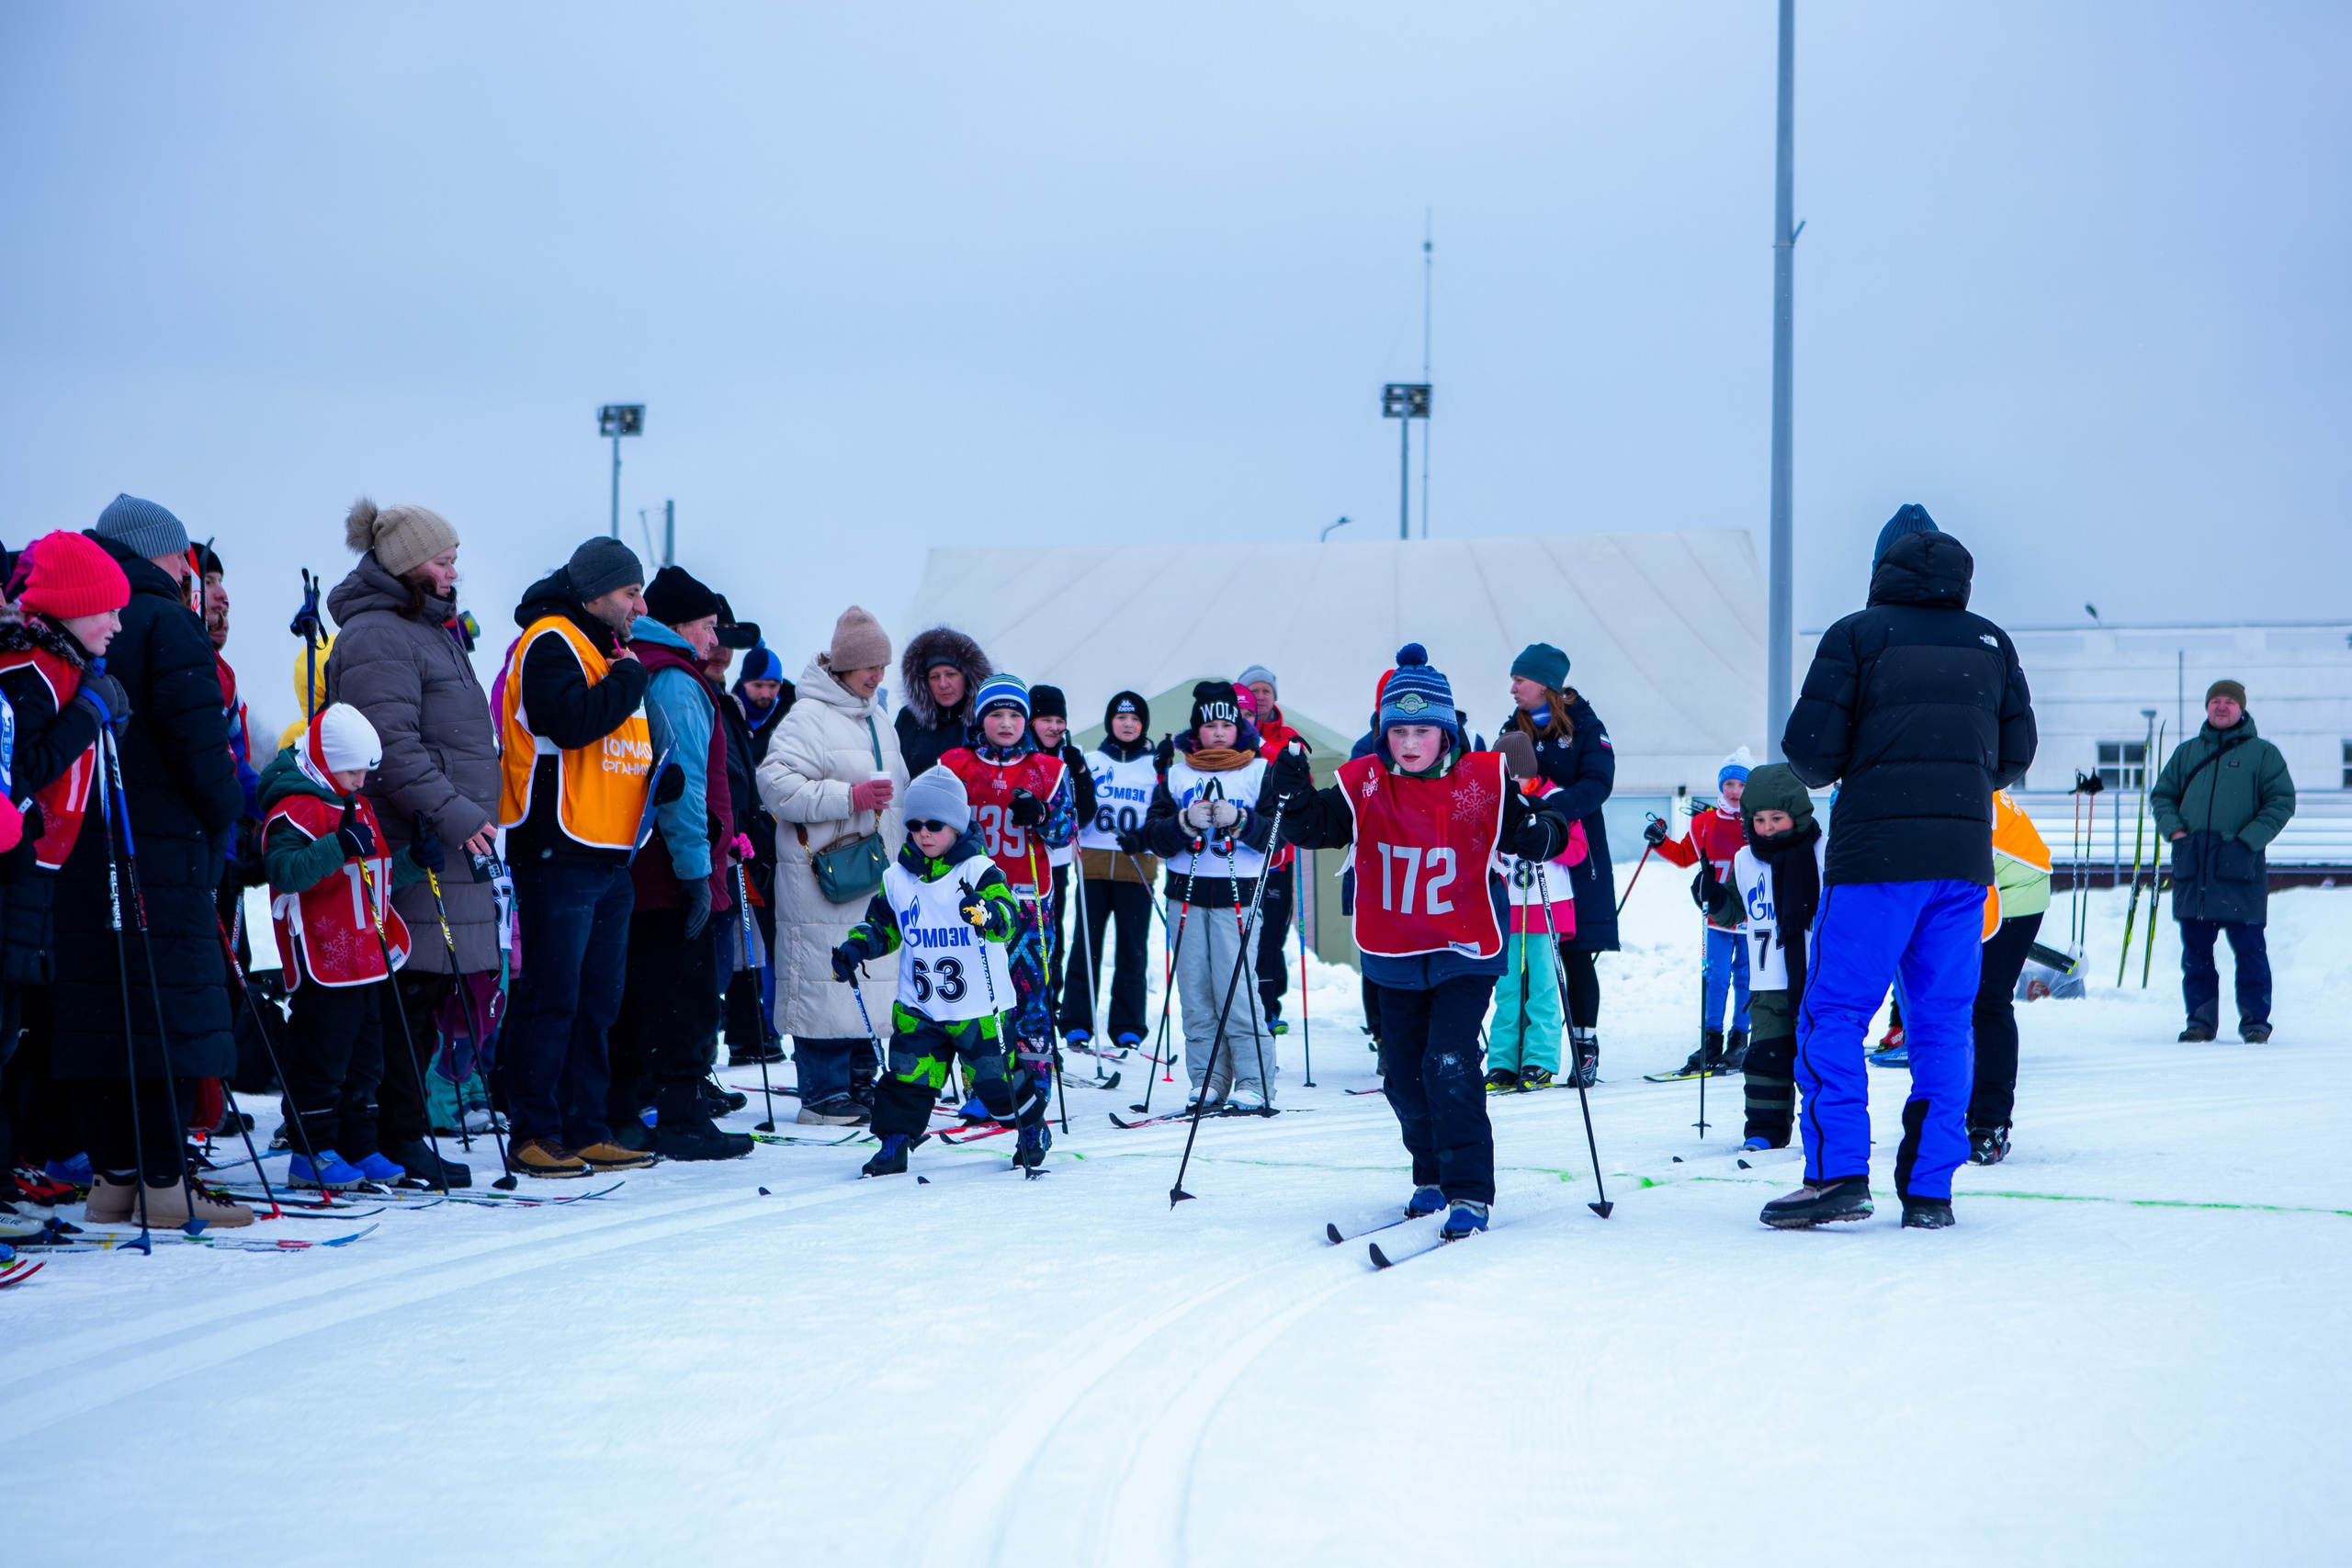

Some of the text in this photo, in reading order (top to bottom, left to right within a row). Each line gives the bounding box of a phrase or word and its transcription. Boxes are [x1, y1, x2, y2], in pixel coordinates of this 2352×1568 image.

[1200, 702, 1238, 723] WOLF
[1094, 804, 1138, 834] 60
[1268, 809, 1283, 851] NORDWAY
[1186, 852, 1199, 901] VUOKATTI
[1227, 852, 1239, 901] VUOKATTI
[1377, 841, 1457, 915] 172
[1540, 876, 1552, 911] NORDWAY
[913, 956, 967, 1003] 63
